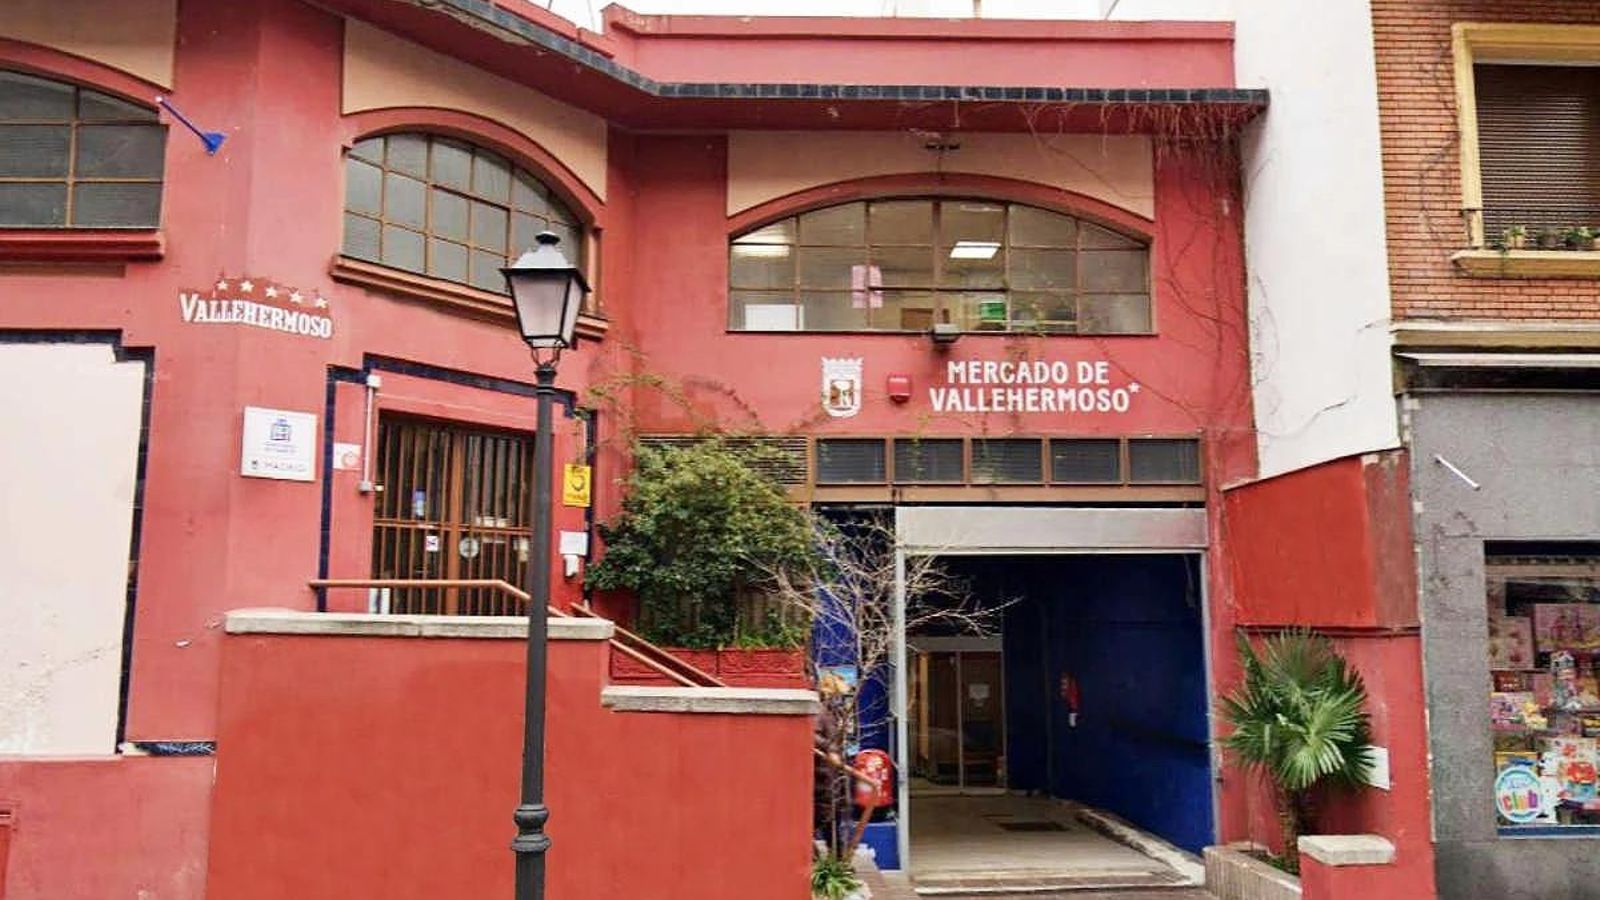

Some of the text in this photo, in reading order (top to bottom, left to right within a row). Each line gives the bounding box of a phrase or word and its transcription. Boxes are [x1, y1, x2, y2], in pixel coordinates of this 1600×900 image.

[179, 293, 332, 339] VALLEHERMOSO
[947, 360, 1110, 384] MERCADO DE
[929, 387, 1131, 413] VALLEHERMOSO
